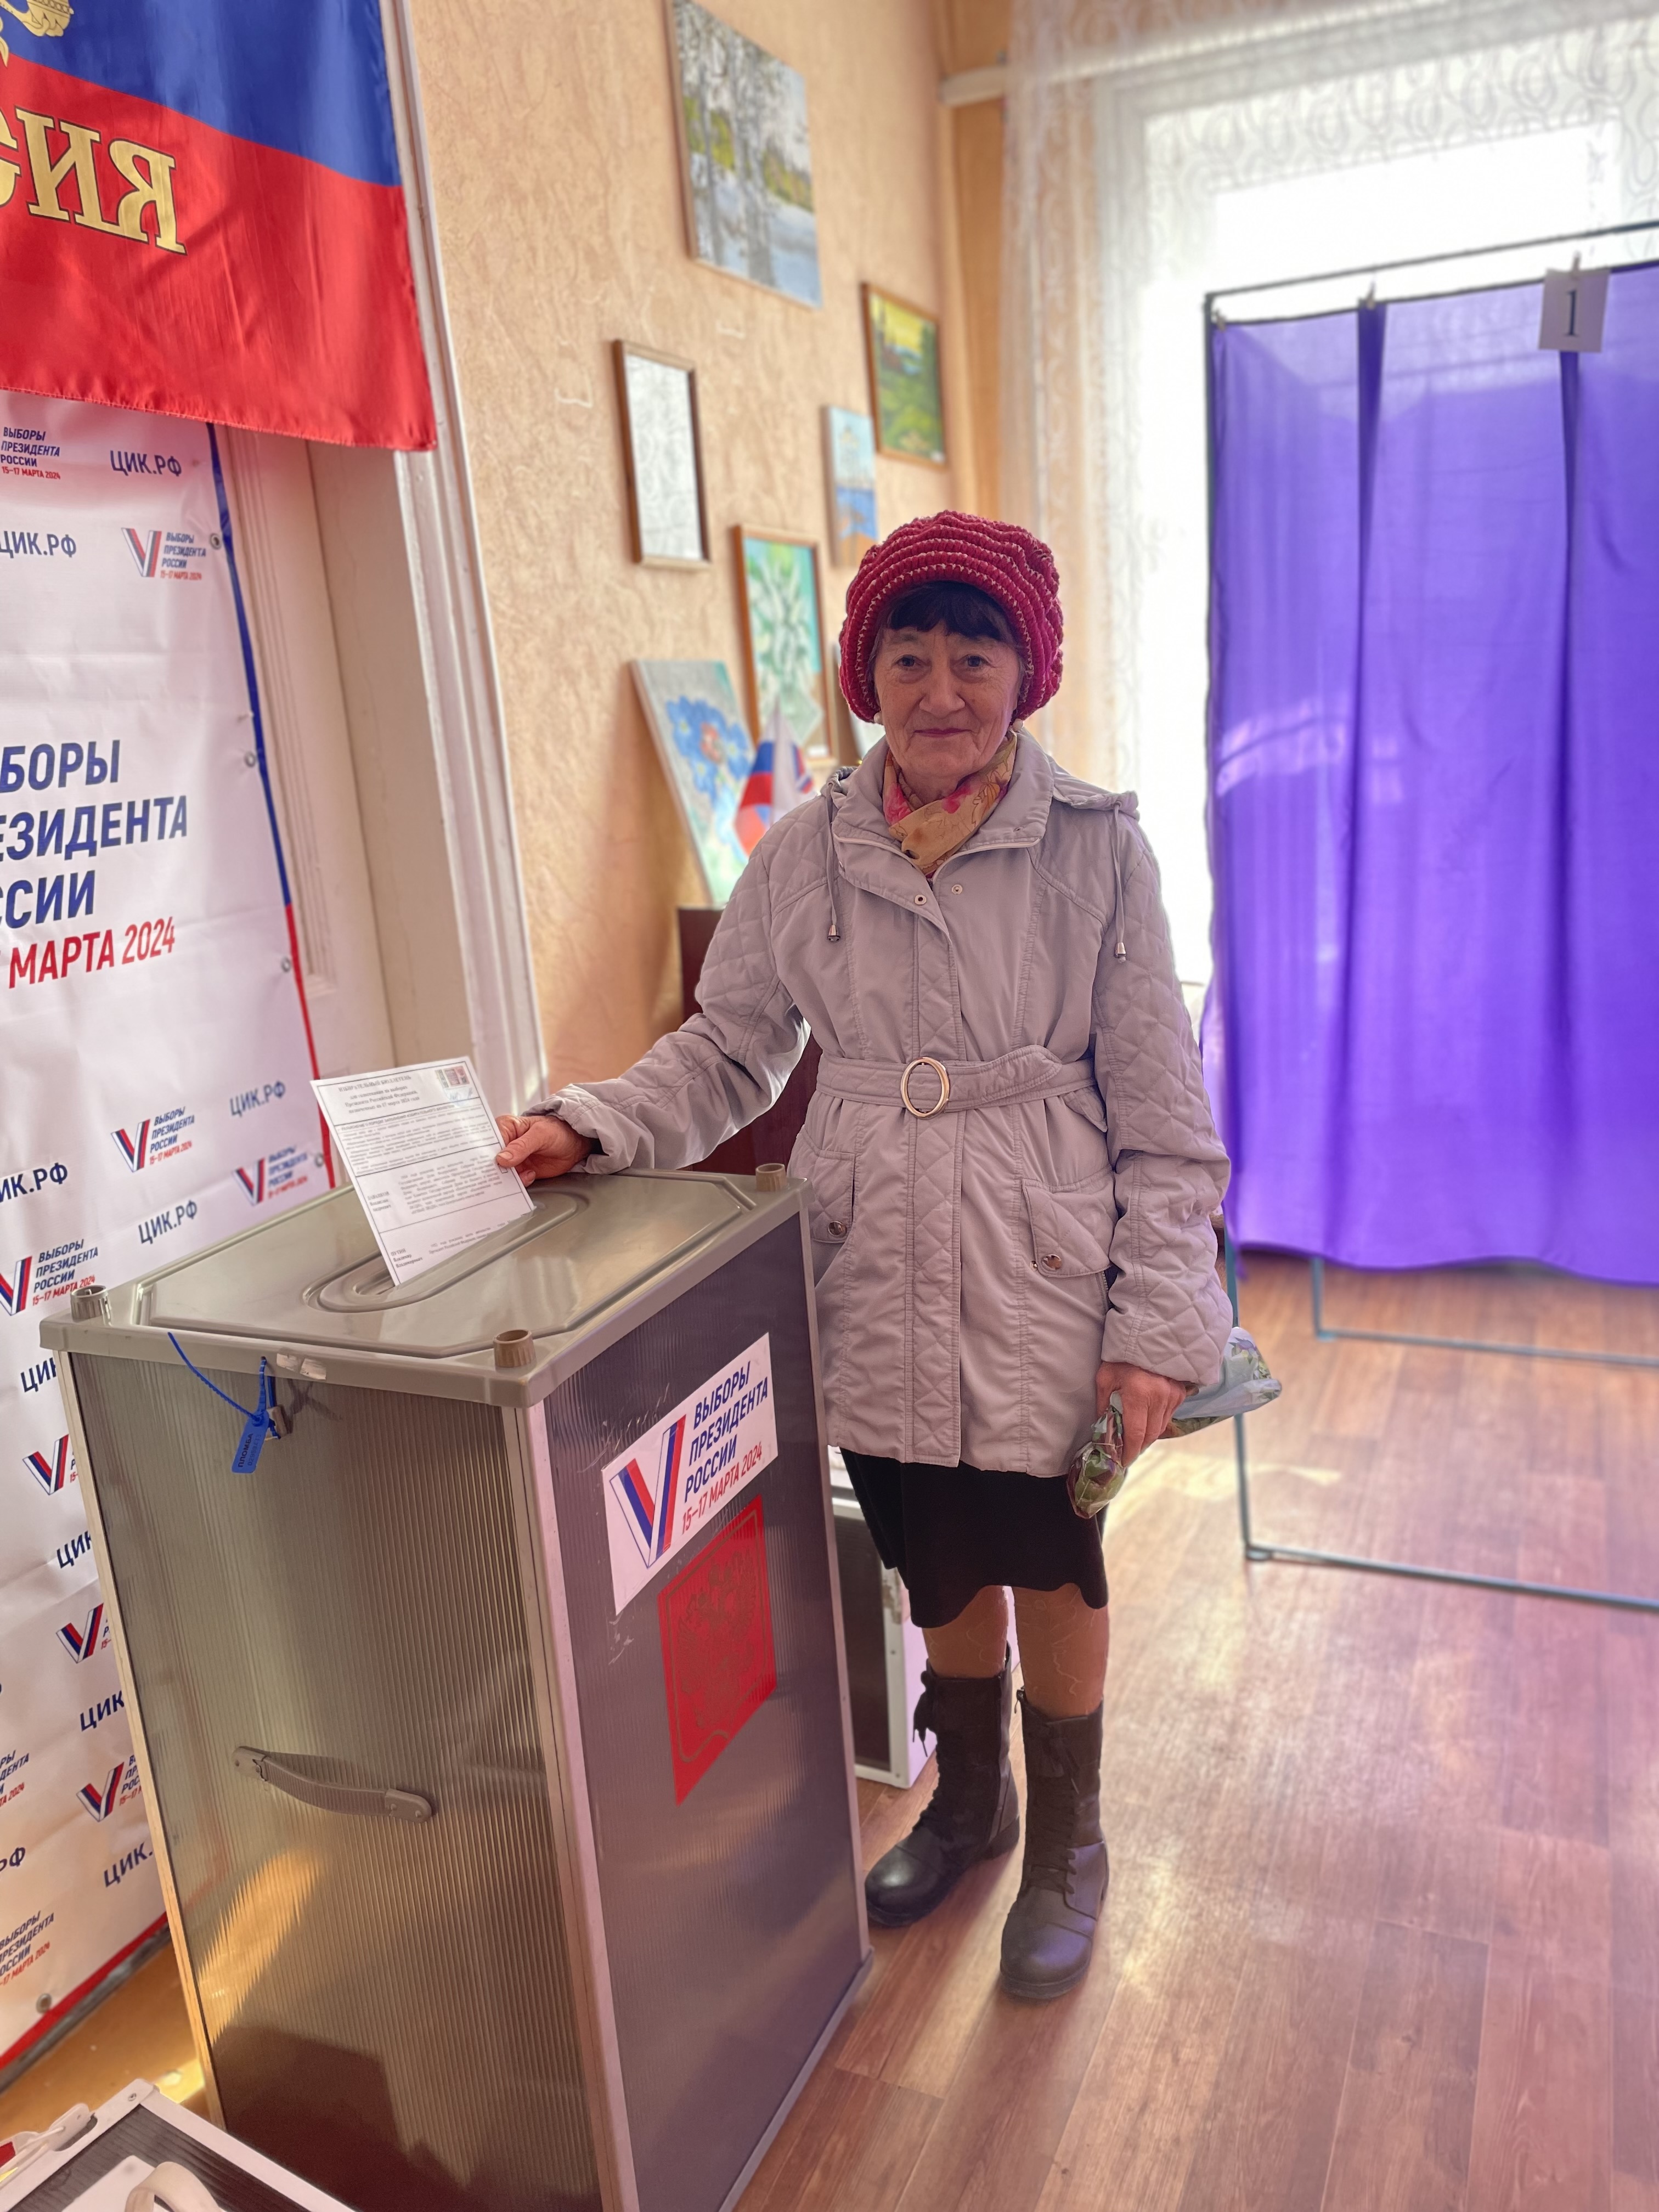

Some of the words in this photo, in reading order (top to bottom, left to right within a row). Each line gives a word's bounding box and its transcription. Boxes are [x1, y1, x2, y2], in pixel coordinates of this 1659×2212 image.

[1565, 289, 1579, 337] 1
[3, 427, 46, 441] ВЫБОРЫ
[0, 454, 37, 467] РОССИИ
[1, 441, 60, 457] ПРЕЗИДЕНТА
[21, 468, 44, 478] МАРТА
[45, 471, 61, 480] 2024
[110, 450, 182, 477] ЦИК.РФ
[163, 545, 206, 557] ПРЕЗИДЕНТА
[166, 532, 194, 544] ВЫБОРЫ
[162, 558, 188, 568] РОССИИ
[0, 870, 95, 929] СИИ
[9, 929, 114, 989] МАРТА
[122, 917, 175, 964] 2024
[230, 1081, 286, 1118] ЦИК.РФ
[151, 1115, 195, 1140] ПРЕЗИДЕНТА
[154, 1106, 185, 1126] ВЫБОРЫ
[150, 1134, 177, 1153] РОССИИ
[138, 1200, 197, 1244] ЦИК.РФ
[36, 1247, 98, 1278] ПРЕЗИДЕНТА
[38, 1239, 84, 1263] ВЫБОРЫ
[33, 1269, 75, 1293] РОССИИ
[52, 1282, 78, 1299] МАРТА
[80, 1274, 95, 1288] 2024
[693, 1361, 751, 1430] ВЫБОРЫ
[689, 1376, 768, 1466] ПРЕЗИДЕНТА
[238, 1433, 253, 1468] ПЛОМБА
[684, 1434, 737, 1504] РОССИИ
[708, 1462, 739, 1508] МАРТА
[741, 1441, 763, 1477] 2024
[80, 1690, 125, 1732] ЦИК
[12, 1954, 33, 1979] МАРТА
[35, 1941, 50, 1960] 2024
